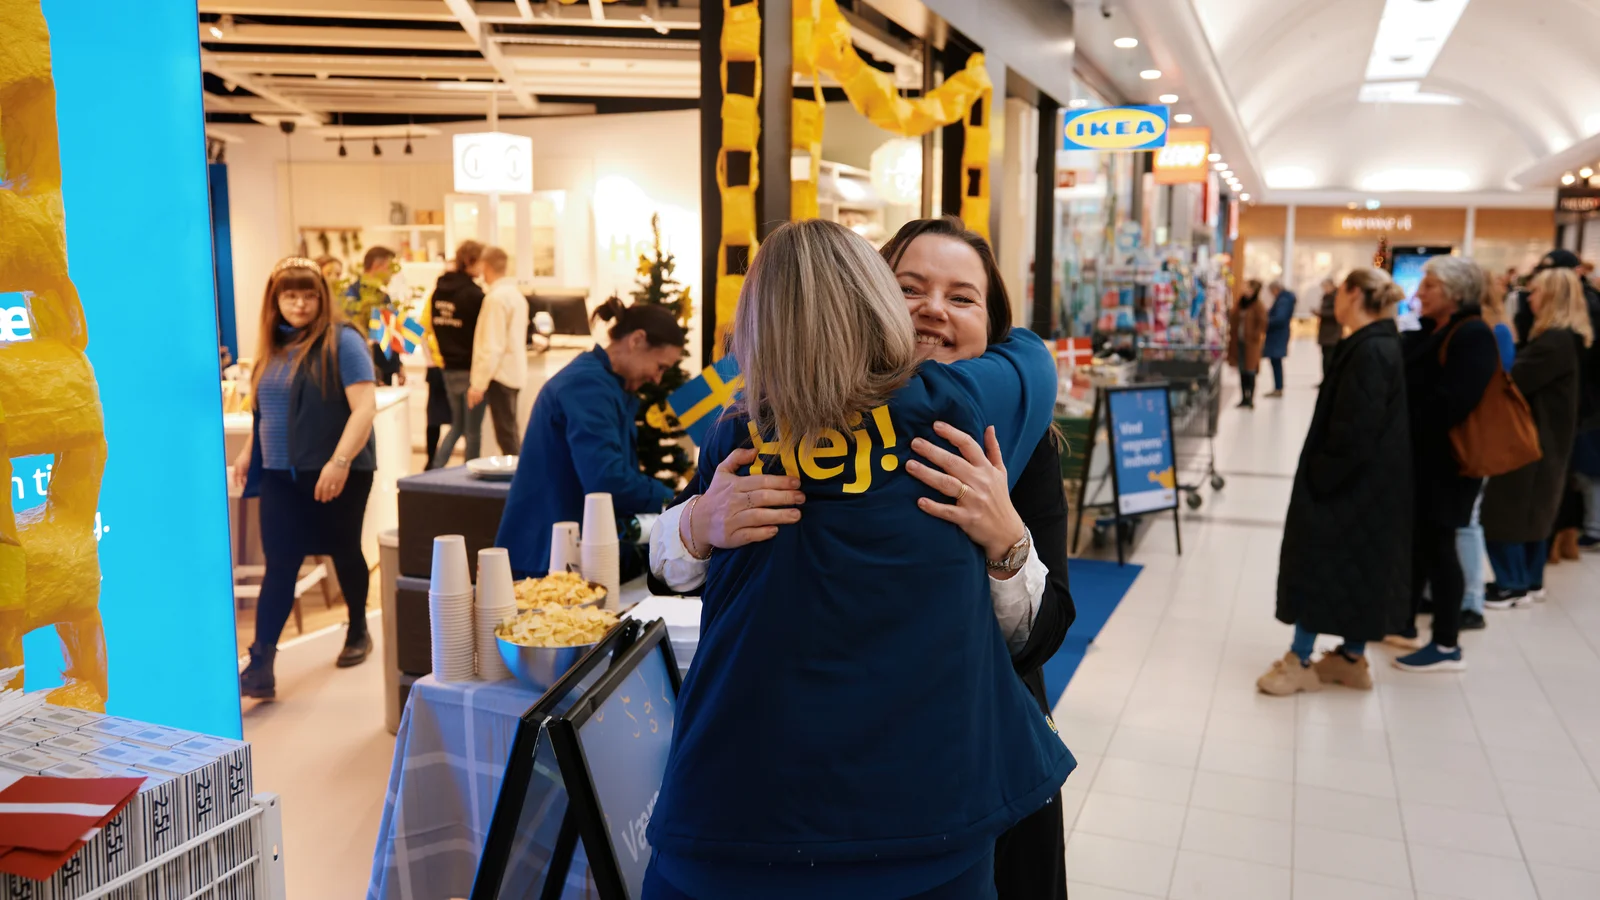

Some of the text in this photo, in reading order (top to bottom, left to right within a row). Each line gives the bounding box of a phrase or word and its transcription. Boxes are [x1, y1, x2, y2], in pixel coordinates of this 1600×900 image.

[1076, 121, 1155, 136] IKEA
[747, 404, 898, 494] Hej!
[196, 779, 212, 822] 2.5L
[229, 761, 244, 803] 2.5L
[154, 796, 170, 841] 2.5L
